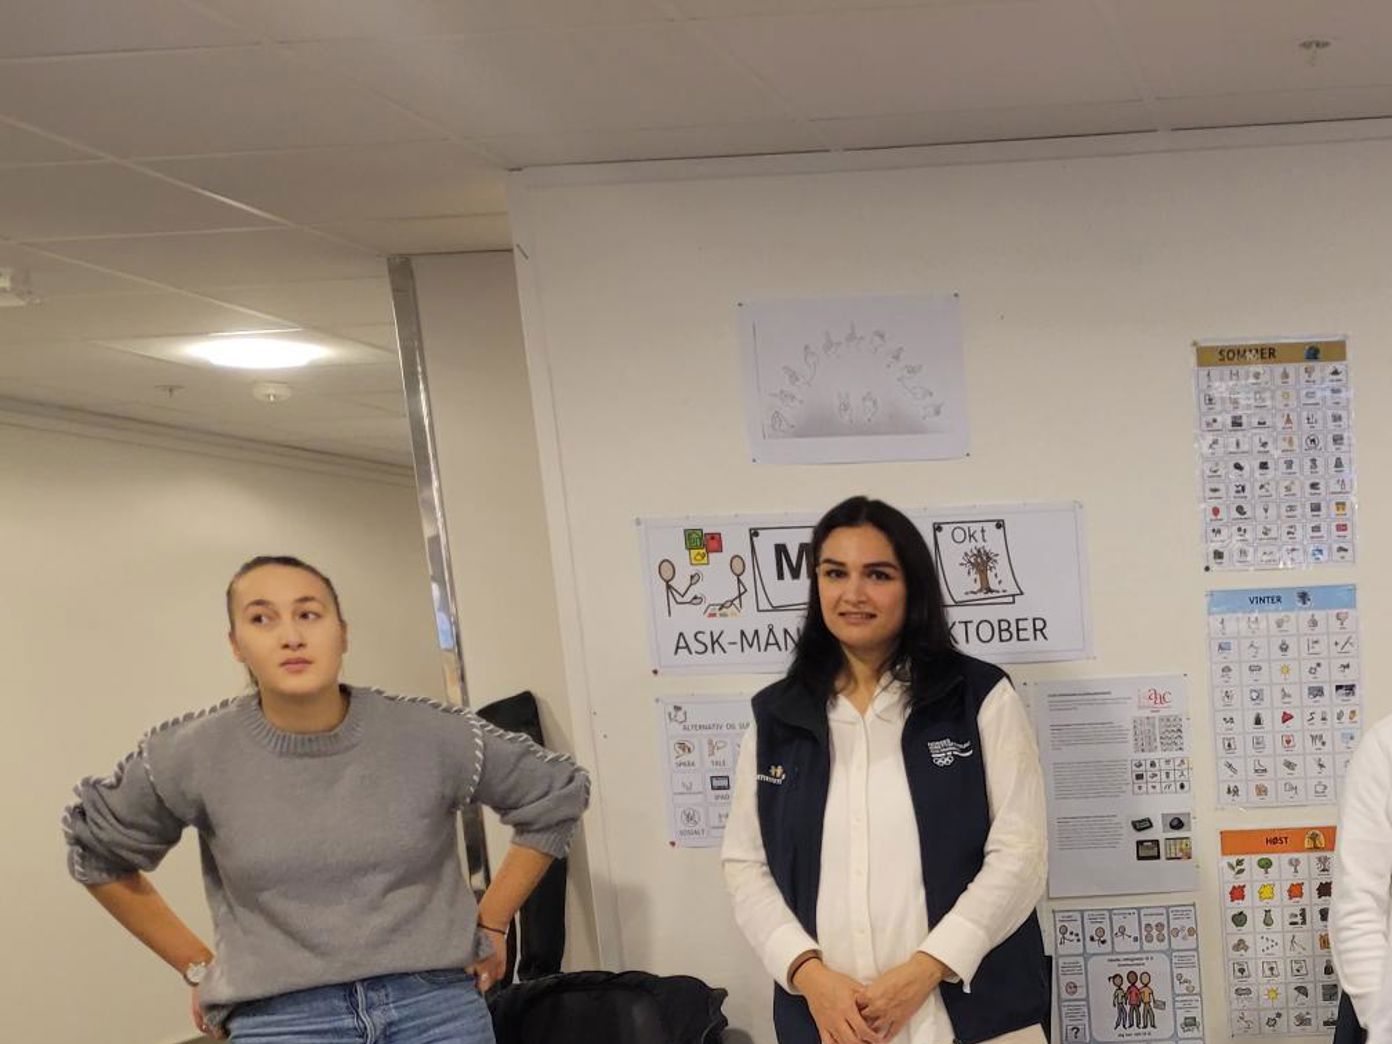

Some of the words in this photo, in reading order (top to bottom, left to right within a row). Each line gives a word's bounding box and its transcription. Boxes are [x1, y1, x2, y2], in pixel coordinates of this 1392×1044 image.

[1218, 347, 1277, 362] SOMMER
[951, 526, 987, 544] Okt
[1248, 594, 1282, 605] VINTER
[1265, 836, 1289, 846] HØST
